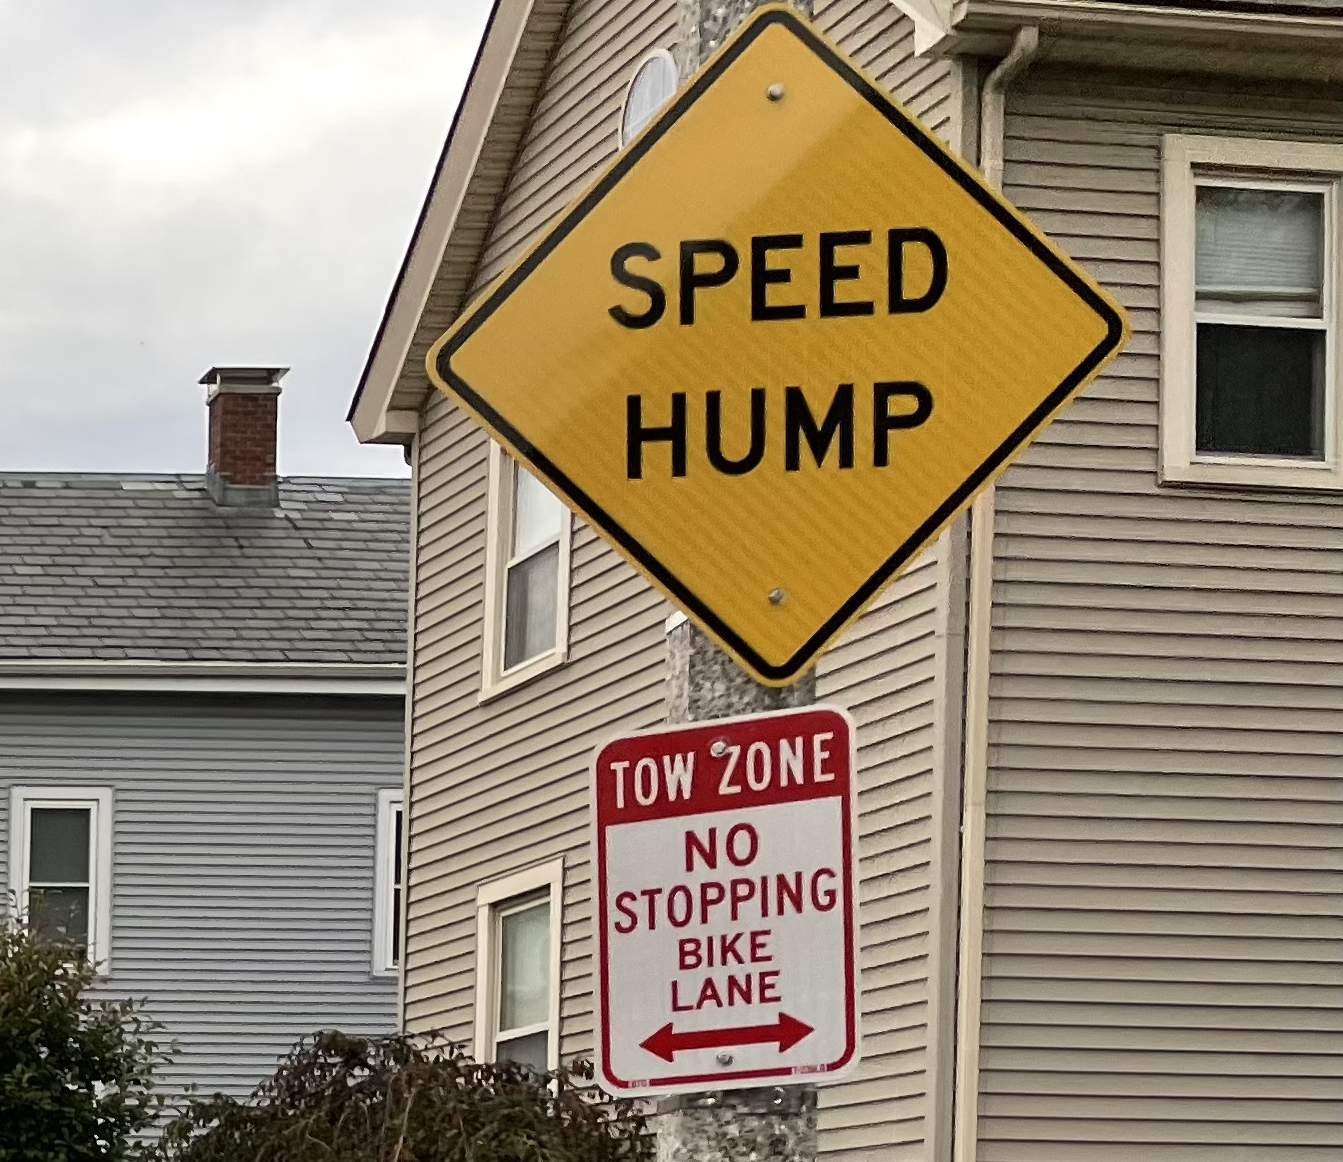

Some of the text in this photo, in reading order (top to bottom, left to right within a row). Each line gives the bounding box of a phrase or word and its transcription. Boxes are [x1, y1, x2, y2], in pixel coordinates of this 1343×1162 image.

[607, 226, 948, 330] SPEED
[625, 380, 934, 481] HUMP
[610, 731, 836, 809] TOW ZONE
[684, 823, 760, 873] NO
[613, 867, 838, 934] STOPPING
[678, 929, 774, 971] BIKE
[671, 970, 783, 1012] LANE
